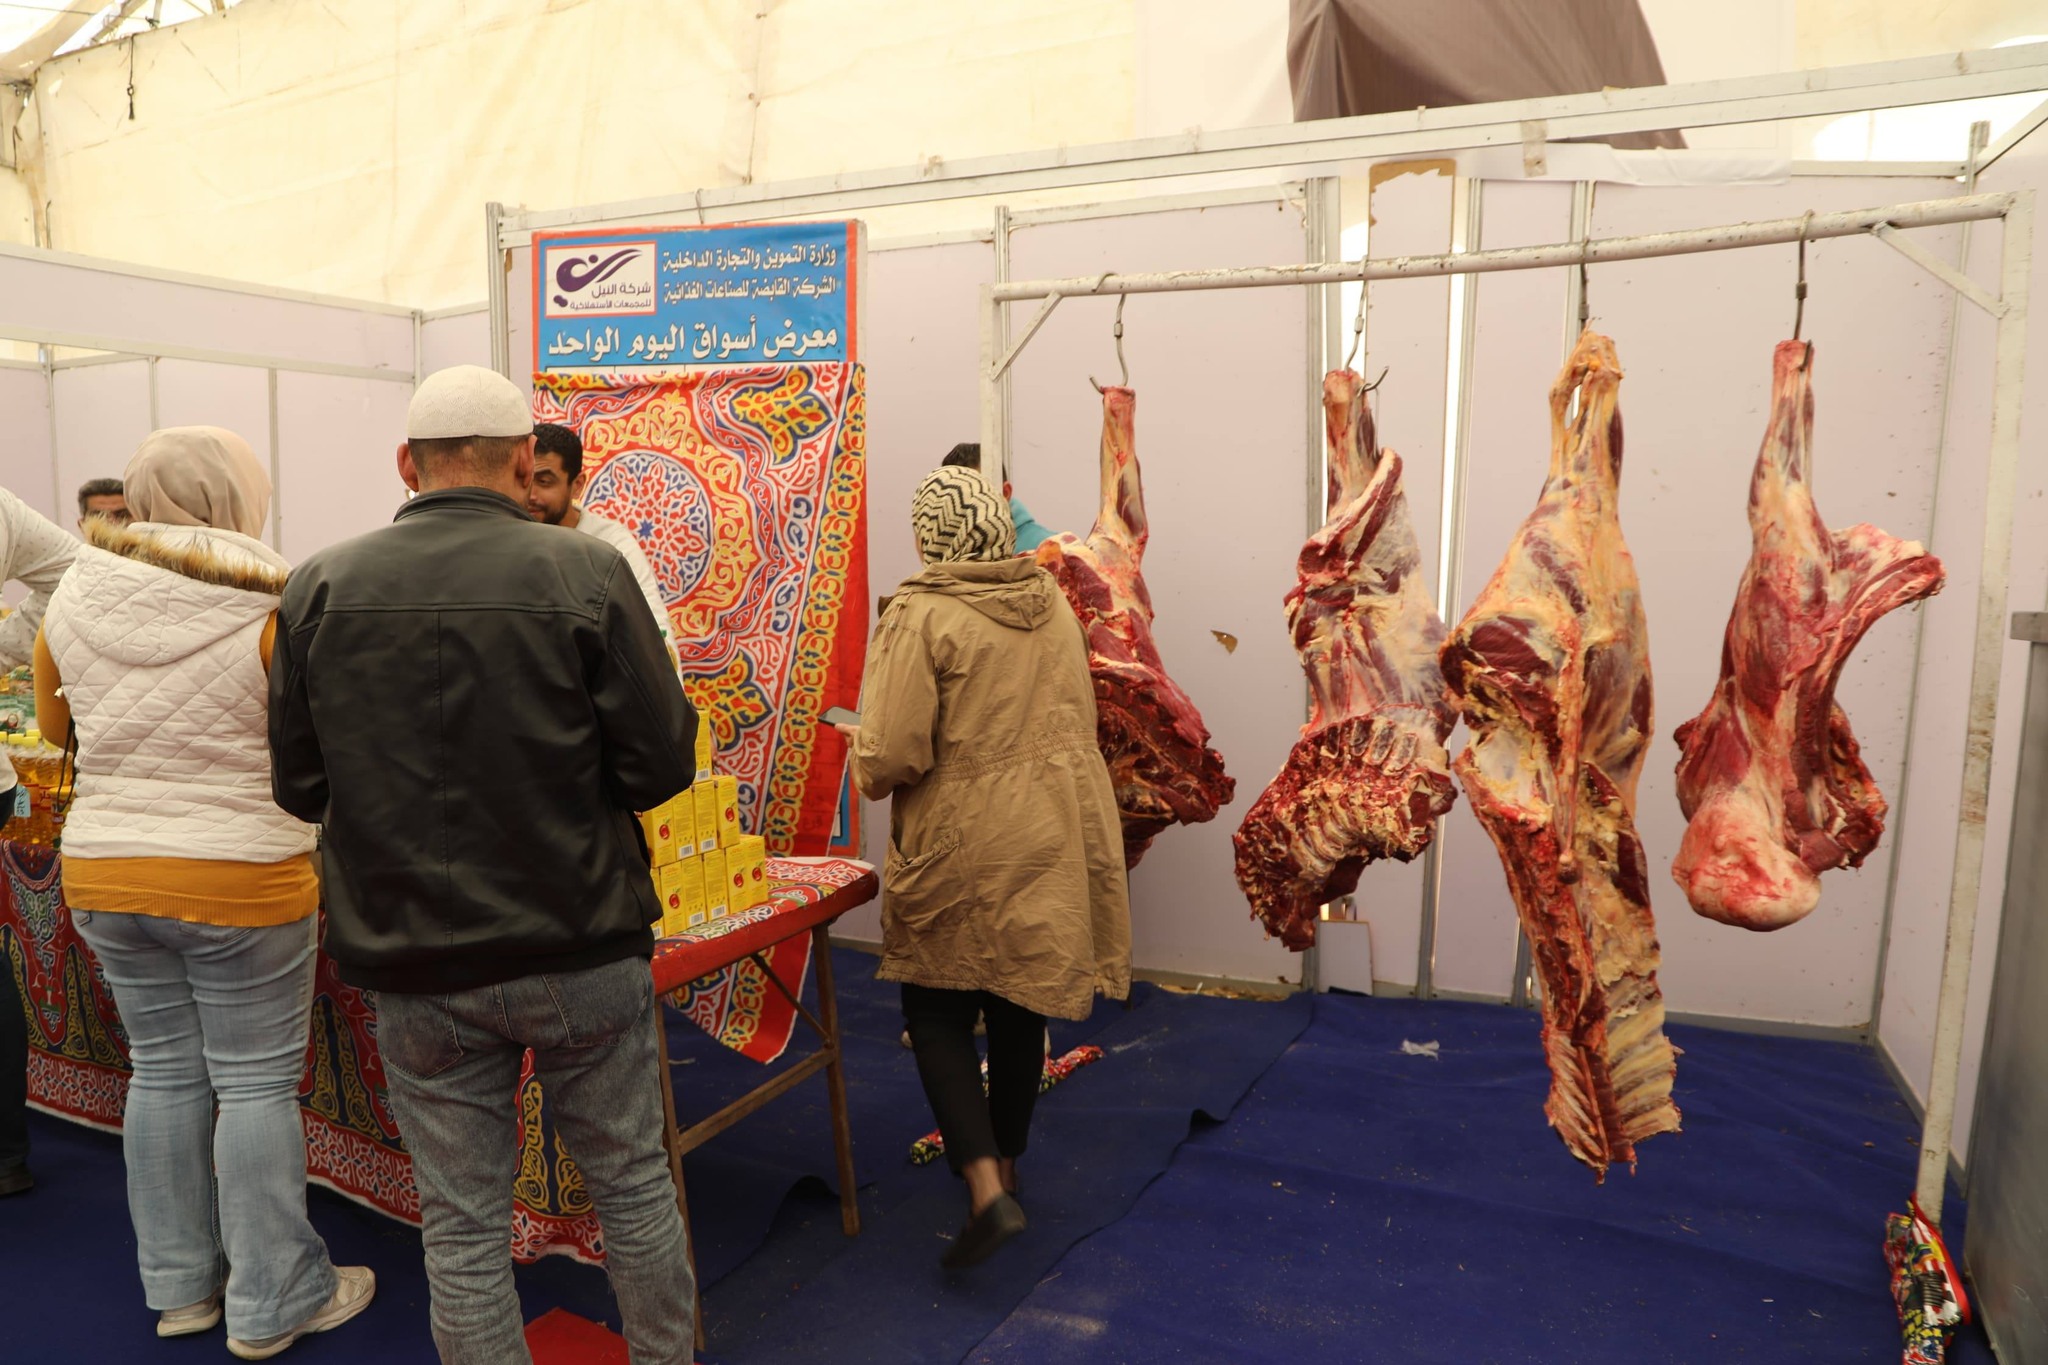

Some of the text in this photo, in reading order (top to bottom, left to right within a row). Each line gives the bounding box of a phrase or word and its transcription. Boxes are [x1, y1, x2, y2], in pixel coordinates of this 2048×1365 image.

[662, 243, 837, 274] وزارة التموين والتجارة الداخلية
[591, 281, 651, 299] شركة النيل
[613, 298, 652, 309] للمجمعات
[663, 275, 837, 305] الشركة القابضة للصناعات الغذائية
[548, 314, 838, 362] معرض أسواق اليوم الواحد
